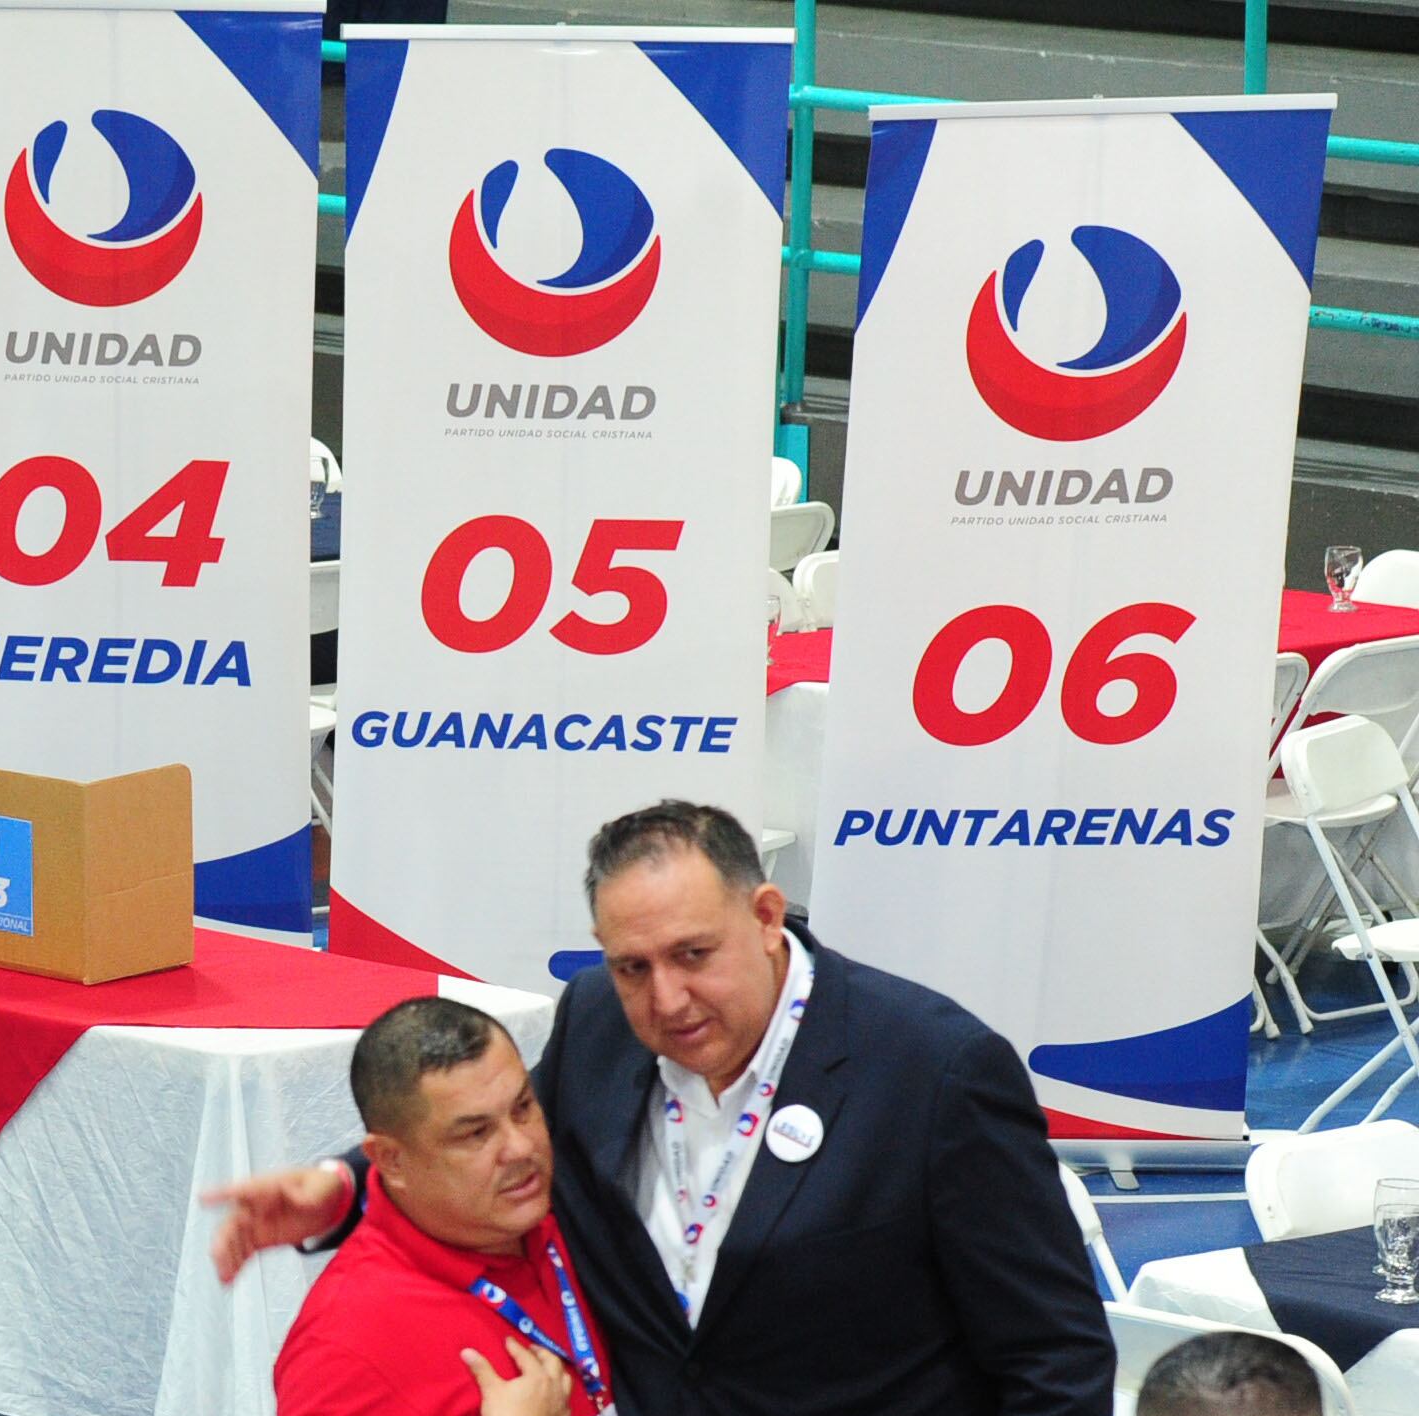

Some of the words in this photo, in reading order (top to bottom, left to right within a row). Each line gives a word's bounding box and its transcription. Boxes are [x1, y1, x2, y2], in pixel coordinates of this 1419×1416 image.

[5, 331, 202, 367] UNIDAD
[4, 373, 51, 383] PARTIDO
[54, 374, 97, 384] UNIDAD
[99, 375, 139, 385] SOCIAL
[142, 375, 200, 386] CRISTIANA
[446, 383, 657, 421] UNIDAD
[444, 428, 495, 437] PARTIDO
[498, 429, 543, 438] UNIDAD
[546, 429, 588, 439] SOCIAL
[591, 430, 653, 440] CRISTIANA
[955, 467, 1174, 506] UNIDAD
[950, 516, 1004, 526] PARTIDO
[1008, 515, 1054, 526] UNIDAD
[1057, 514, 1101, 524] SOCIAL
[1105, 513, 1168, 524] CRISTIANA
[421, 514, 685, 655] 05
[912, 602, 1197, 747] 06
[351, 710, 738, 753] GUANACASTE
[834, 808, 1236, 847] PUNTARENAS
[568, 1305, 590, 1352] UNIDAD
